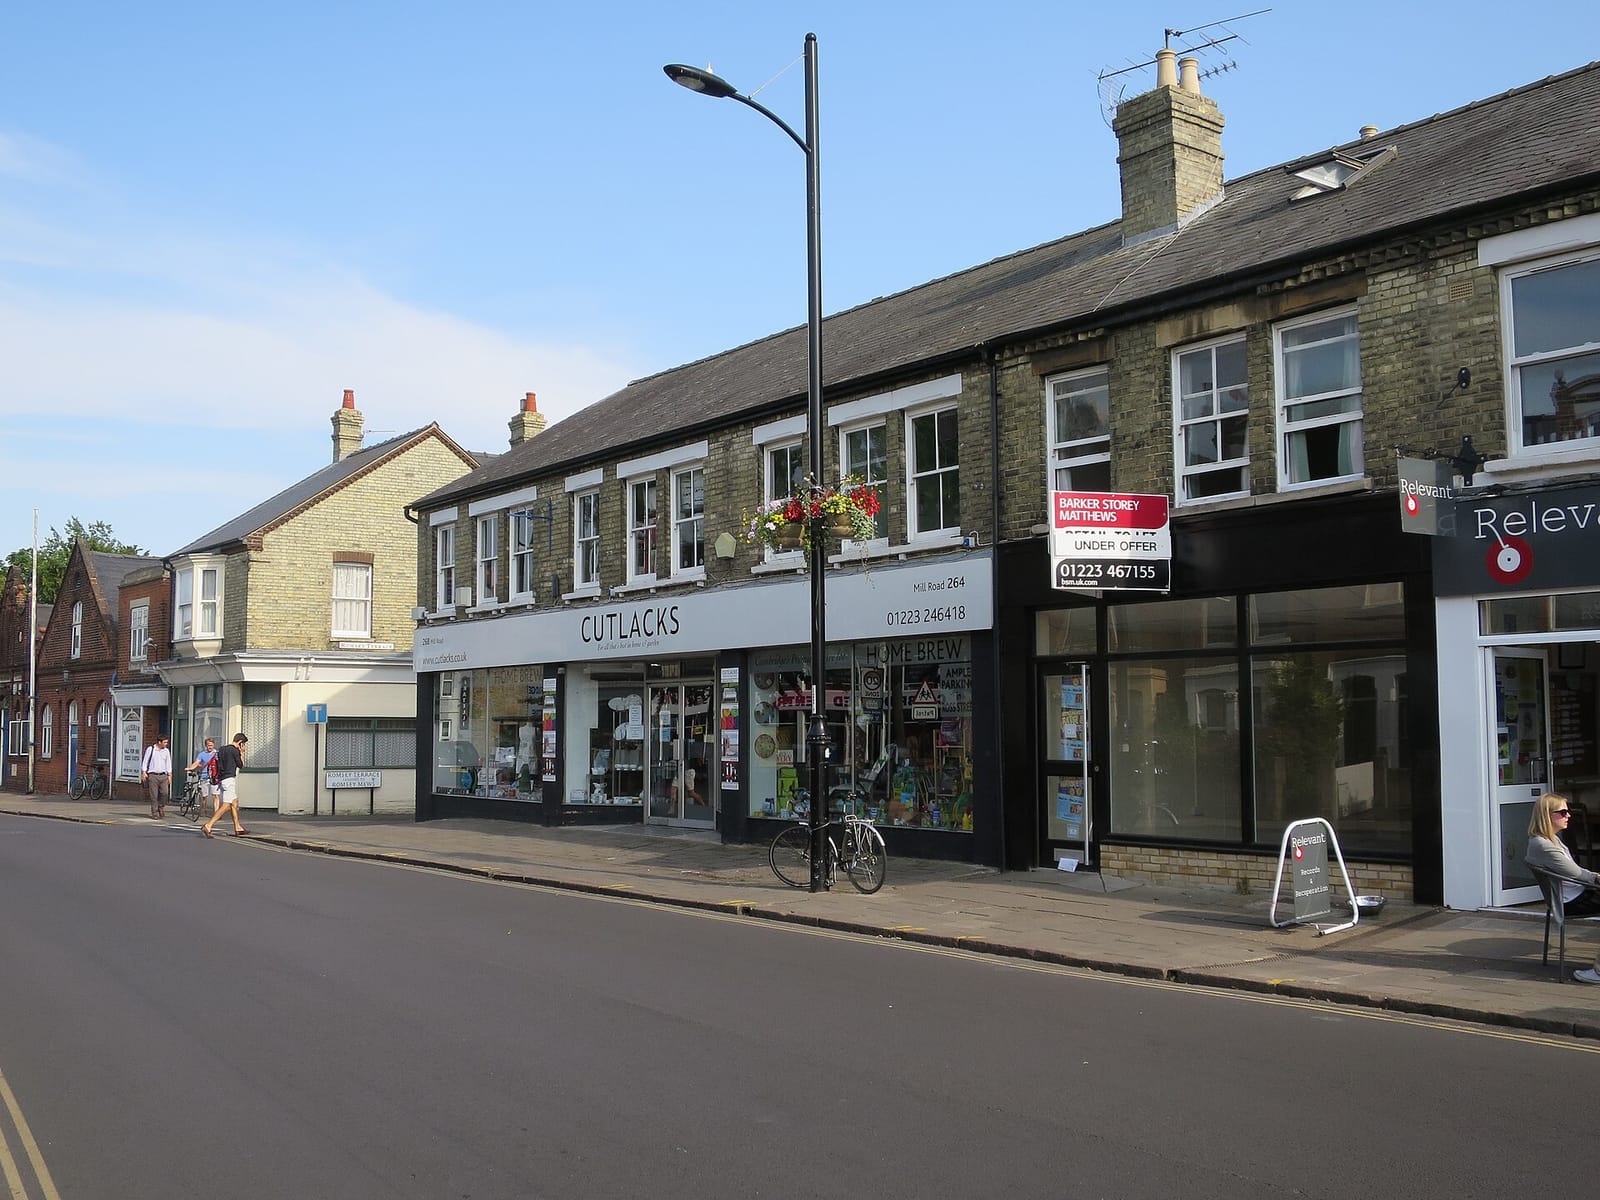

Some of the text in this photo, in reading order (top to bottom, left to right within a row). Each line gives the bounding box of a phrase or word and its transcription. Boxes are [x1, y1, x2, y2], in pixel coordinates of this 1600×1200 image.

[1399, 478, 1453, 500] Relevant
[1059, 498, 1140, 511] BARKER STOREY
[1059, 510, 1117, 523] MATTHEWS
[1074, 540, 1157, 552] UNDER OFFER
[1060, 563, 1156, 579] 01223 467155
[913, 575, 966, 593] Mill Road 264
[1061, 578, 1098, 586] bsm.uk.com
[887, 605, 966, 626] 01223 246418
[581, 605, 680, 643] CUTLACKS
[866, 642, 912, 664] HOME
[917, 639, 962, 661] BREW
[945, 667, 972, 678] AMPLE
[1291, 833, 1327, 848] Relevant
[1300, 865, 1320, 876] Records
